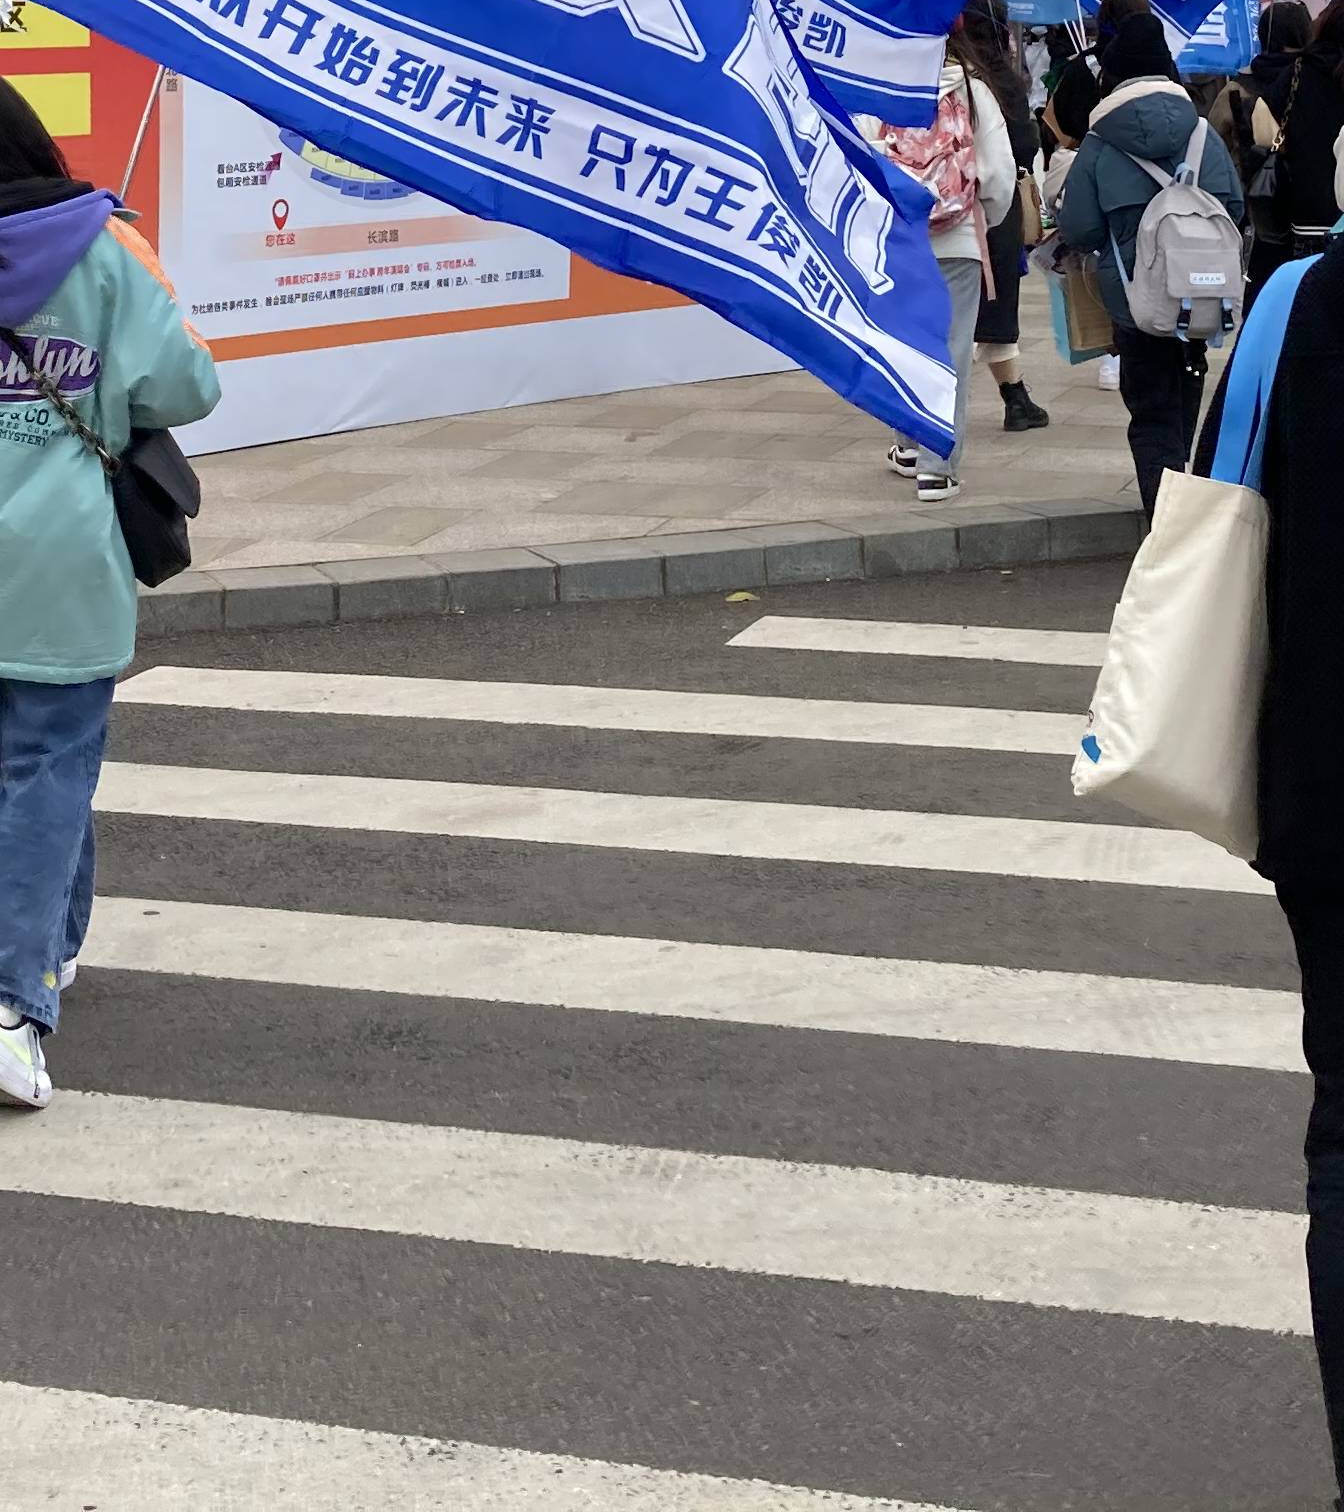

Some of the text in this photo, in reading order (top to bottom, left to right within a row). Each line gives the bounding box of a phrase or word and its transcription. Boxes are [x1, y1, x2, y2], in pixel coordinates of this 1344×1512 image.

[579, 124, 844, 321] 只为王俊凯
